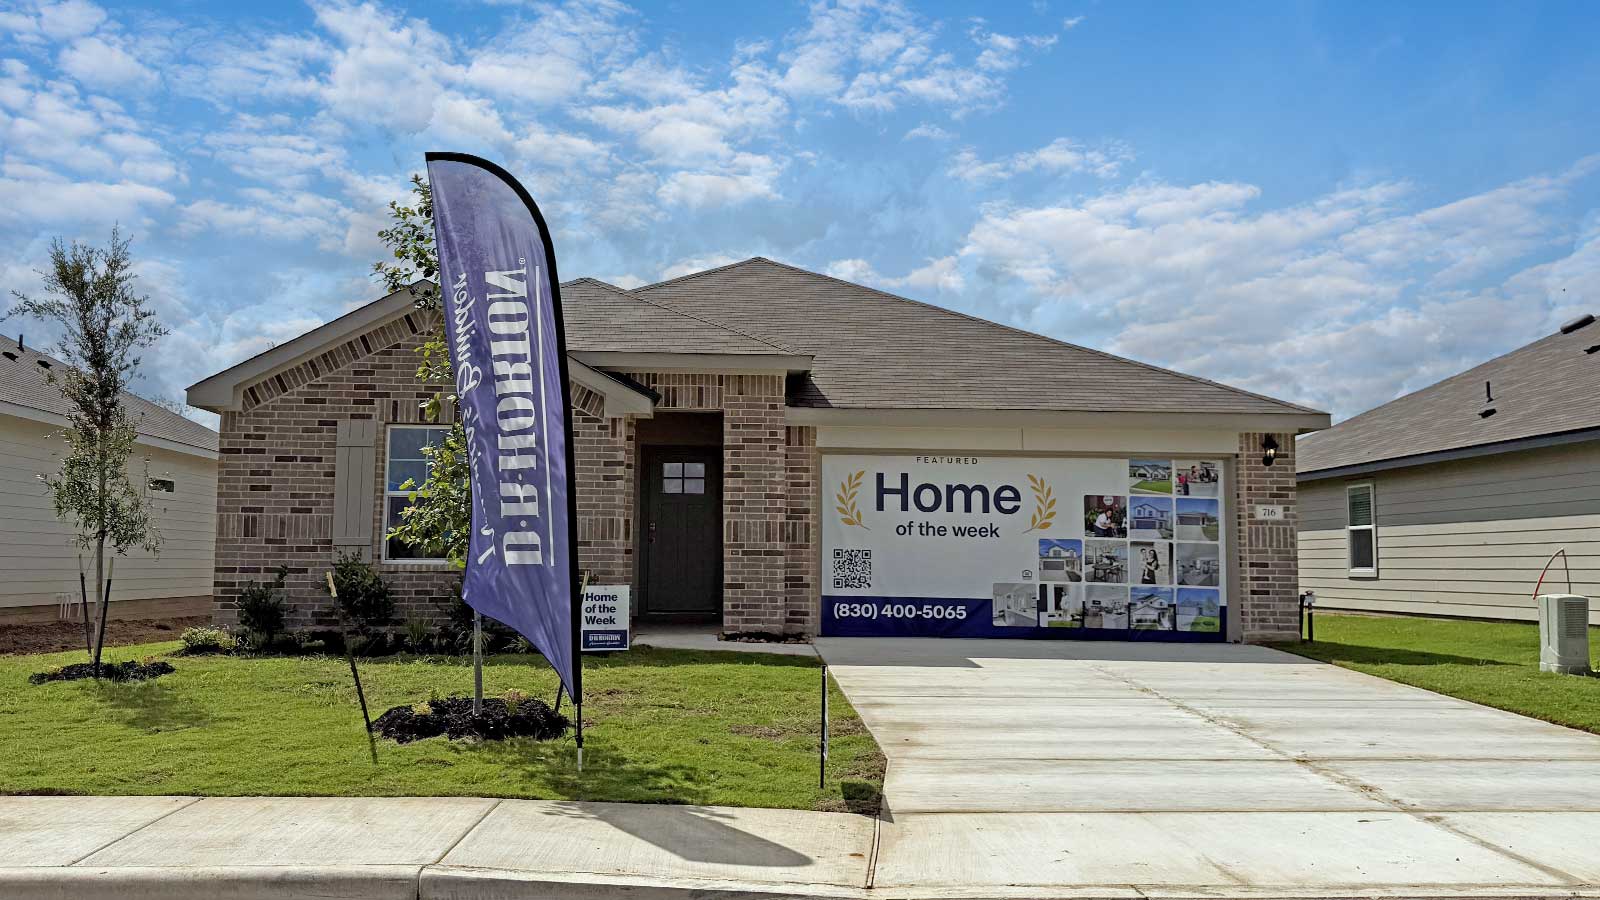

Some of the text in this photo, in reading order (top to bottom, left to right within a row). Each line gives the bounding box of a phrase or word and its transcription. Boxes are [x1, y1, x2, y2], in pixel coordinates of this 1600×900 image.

[916, 456, 979, 465] FEATURED
[876, 472, 1022, 514] Home
[1262, 508, 1276, 516] 716
[895, 521, 1000, 538] of the week
[585, 593, 618, 602] Home
[585, 604, 616, 613] of the
[833, 602, 967, 620] (830) 400-5065
[585, 615, 616, 625] Week
